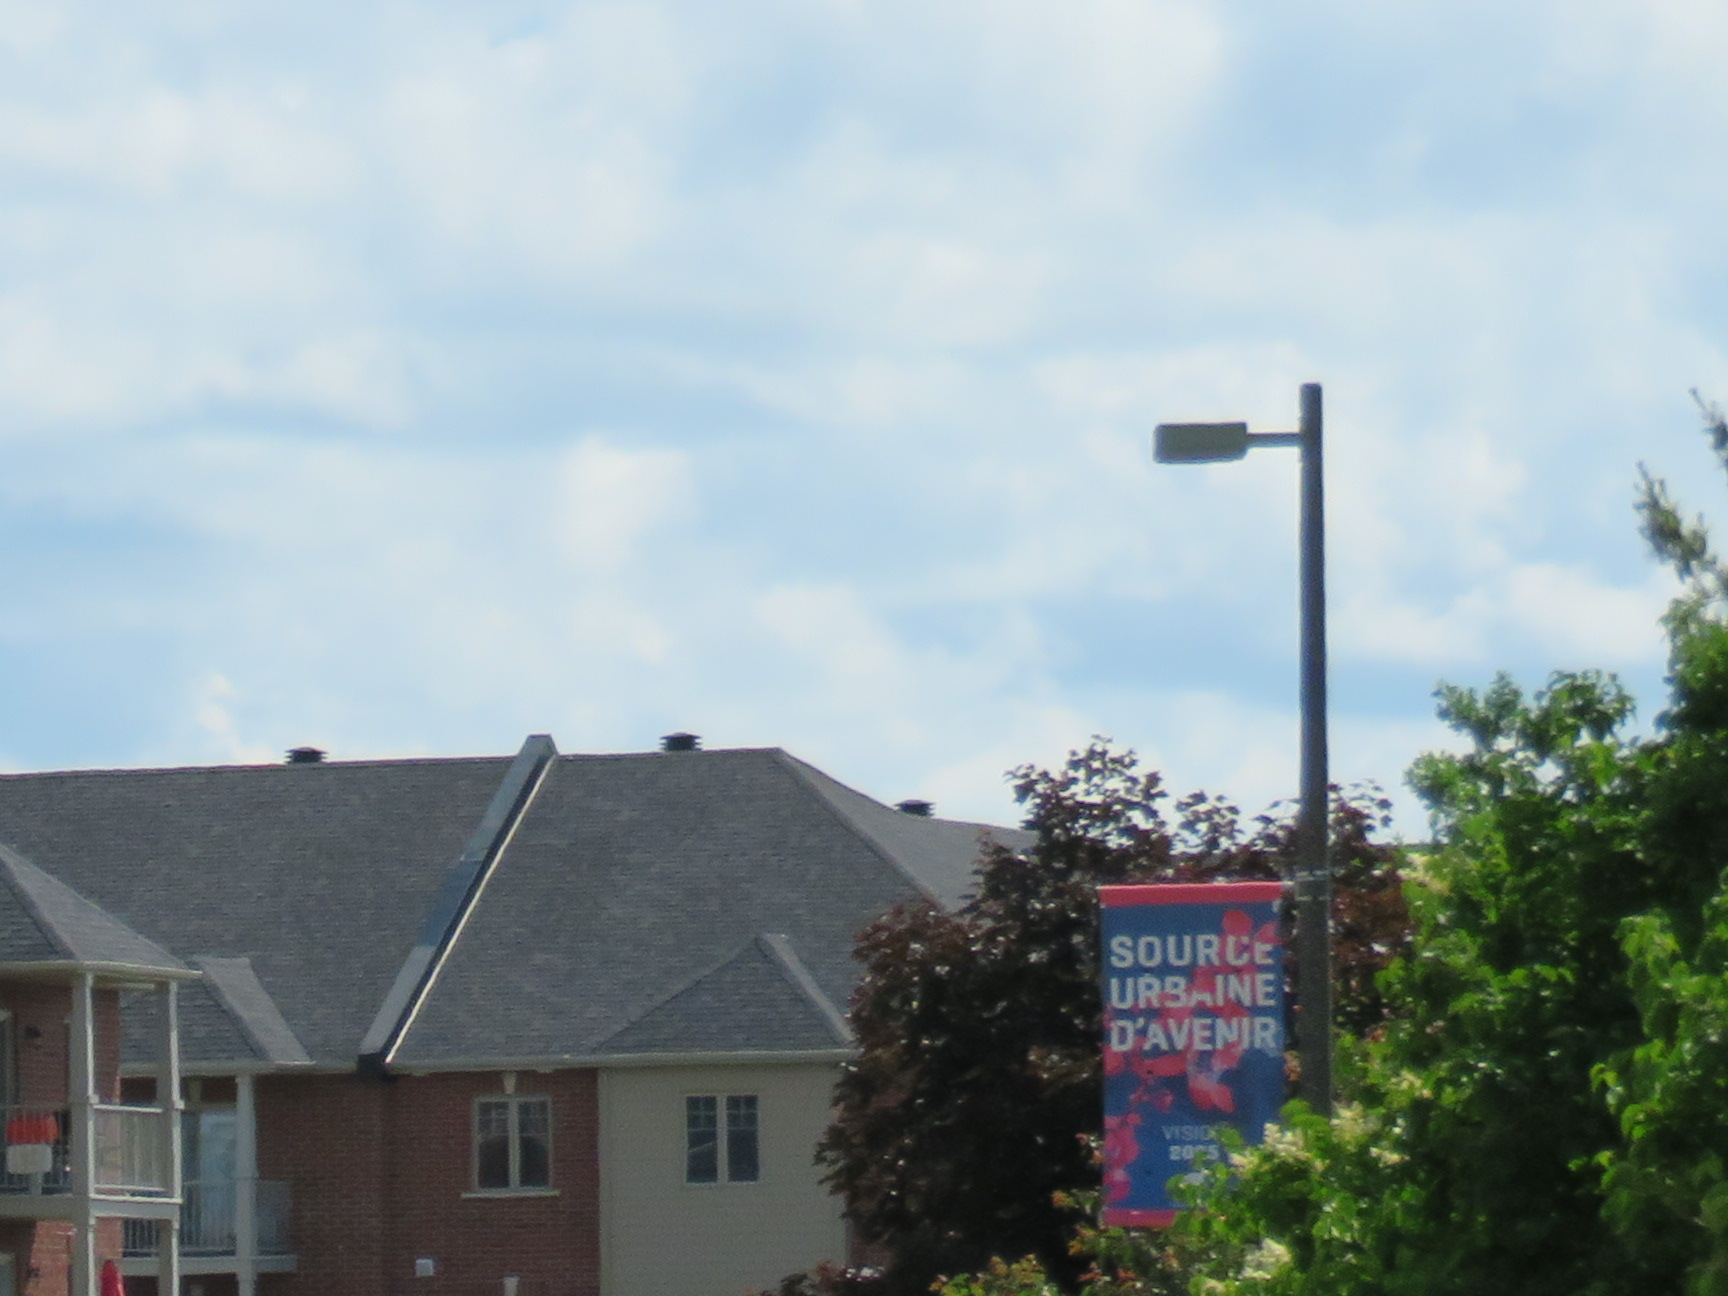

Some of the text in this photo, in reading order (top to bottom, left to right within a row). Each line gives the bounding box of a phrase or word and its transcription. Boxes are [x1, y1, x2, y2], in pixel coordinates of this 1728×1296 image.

[1110, 934, 1275, 968] SOURCE
[1109, 973, 1277, 1010] URBAINE
[1110, 1017, 1278, 1051] D'AVENIR
